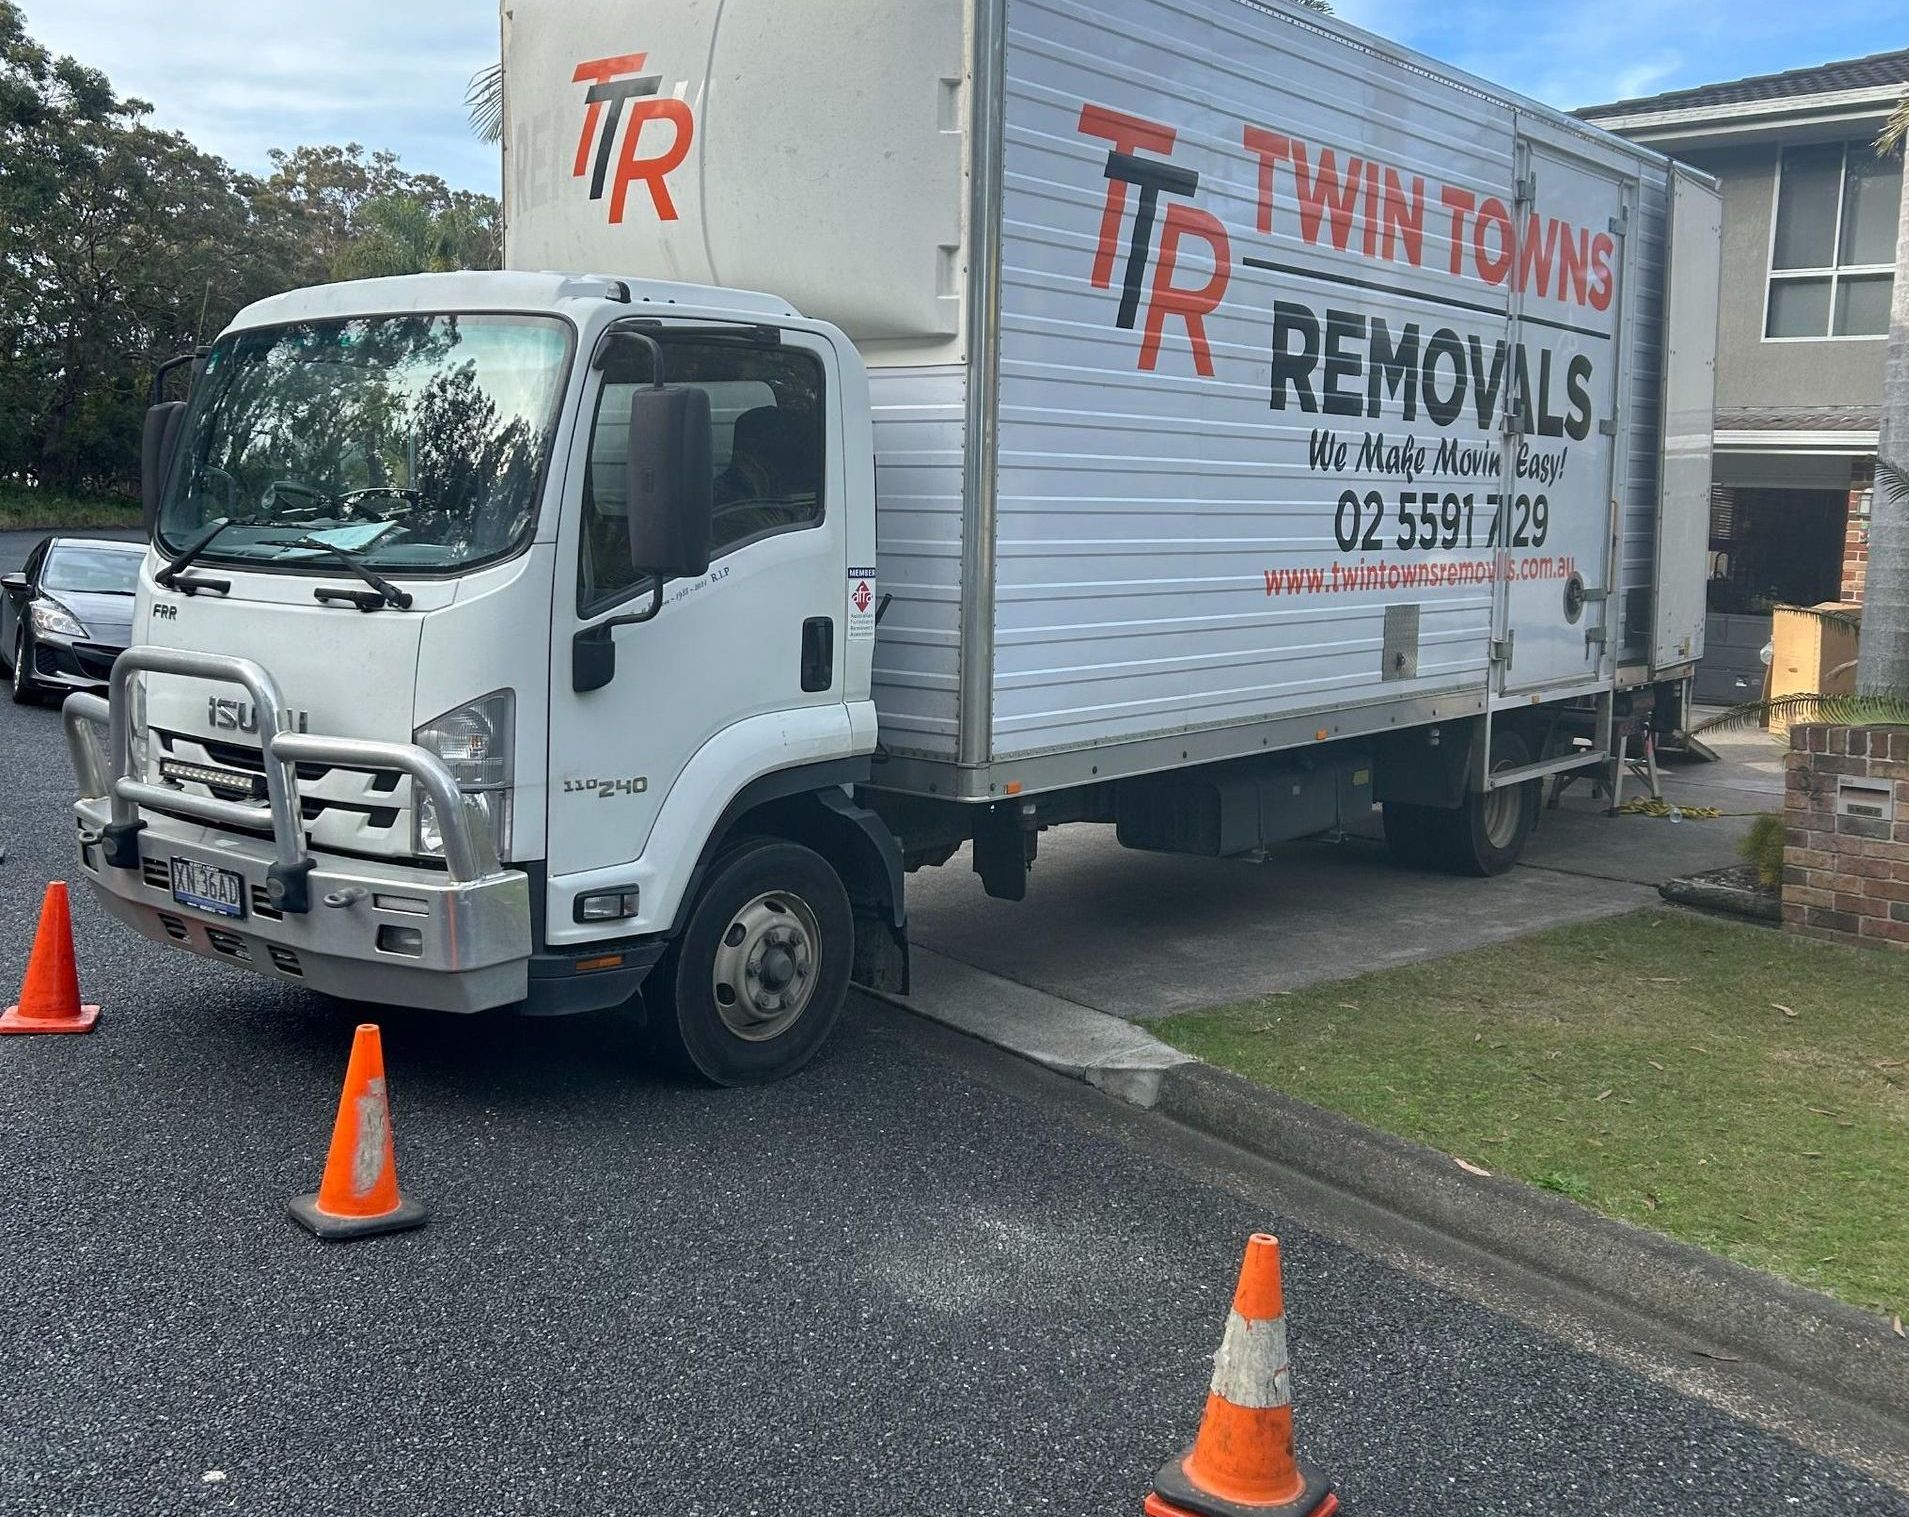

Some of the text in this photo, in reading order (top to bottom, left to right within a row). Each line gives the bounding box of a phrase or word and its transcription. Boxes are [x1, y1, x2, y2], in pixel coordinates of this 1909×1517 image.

[571, 52, 694, 224] TTR
[1078, 103, 1231, 377] TTR
[1243, 124, 1614, 312] TWIN TOWNS
[1270, 299, 1593, 441] REMOVALS
[1309, 428, 1567, 488] We Make Movin Easy!
[1335, 489, 1384, 552] 02
[1396, 492, 1474, 551] 5591
[152, 603, 178, 621] FRR
[208, 696, 308, 734] ISUU
